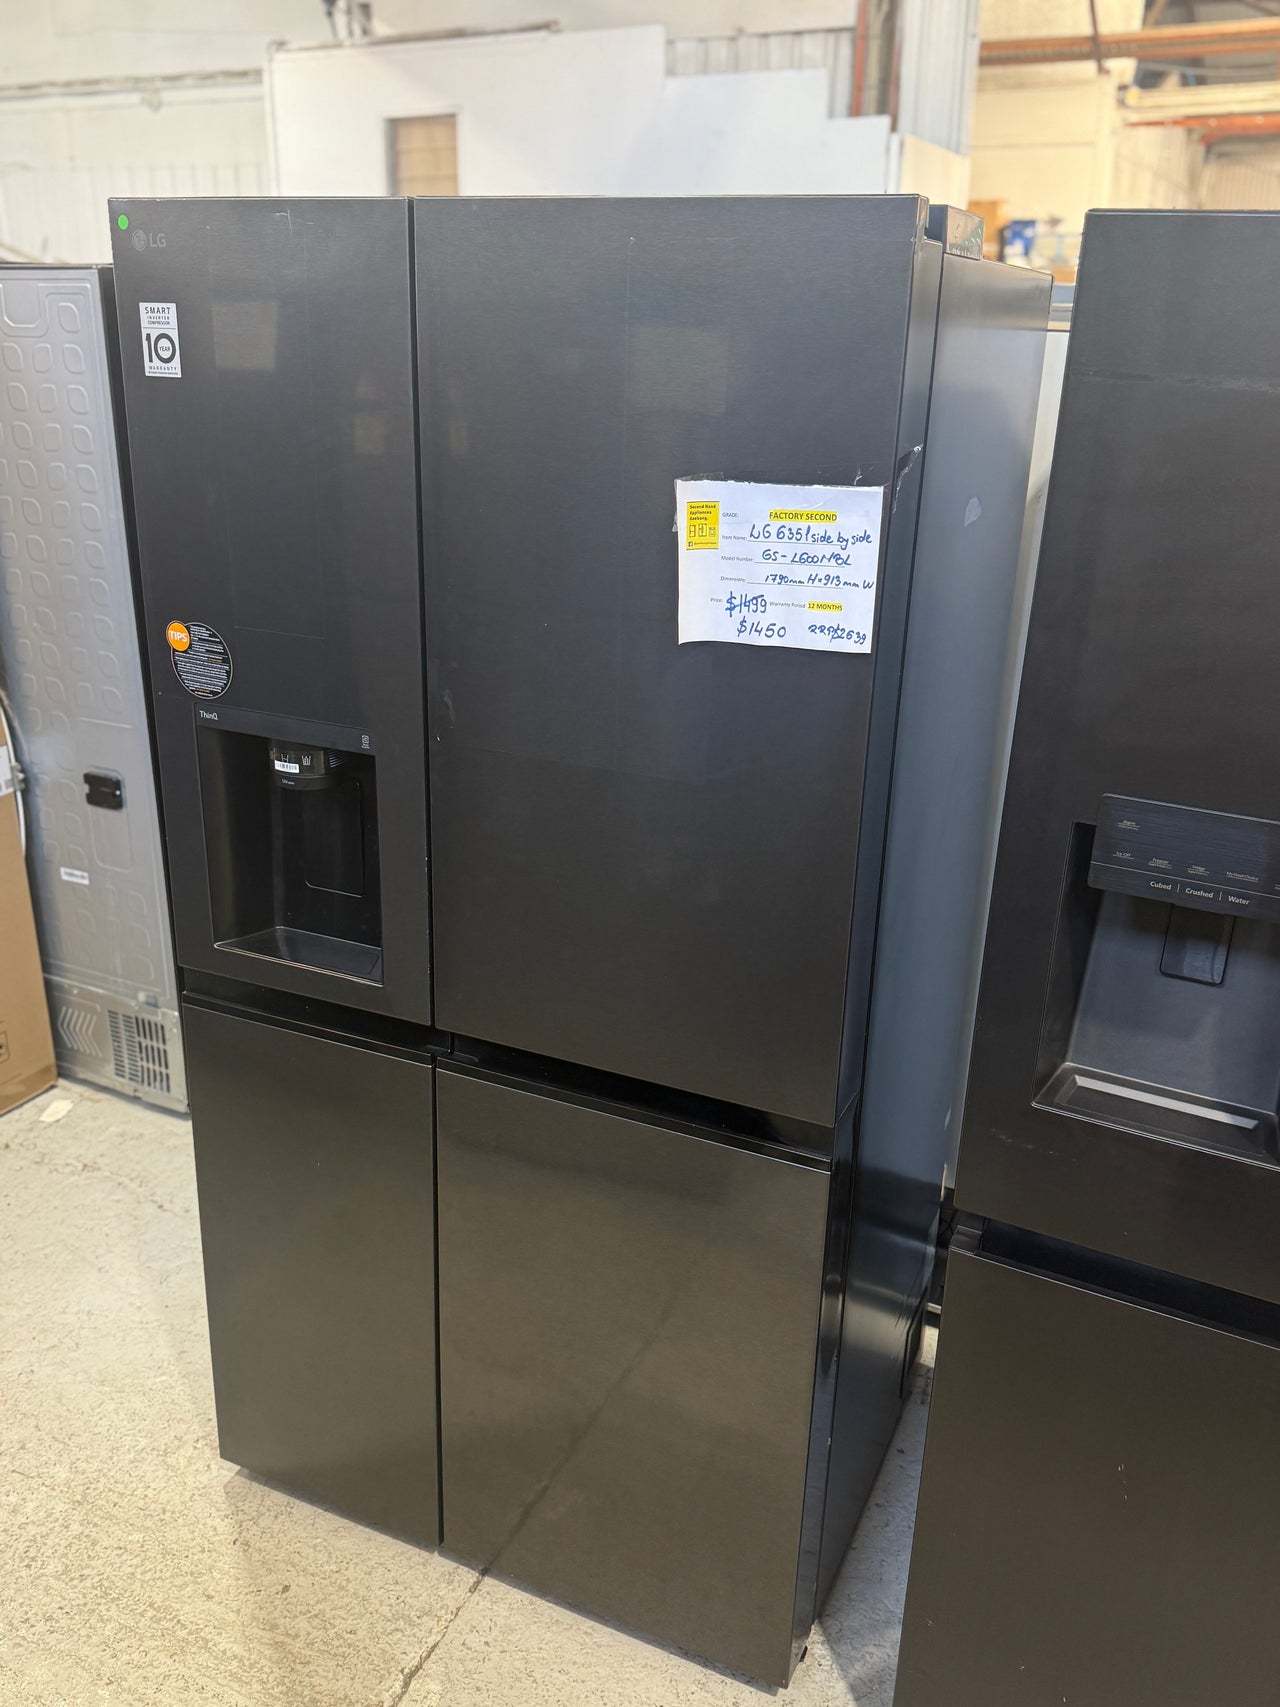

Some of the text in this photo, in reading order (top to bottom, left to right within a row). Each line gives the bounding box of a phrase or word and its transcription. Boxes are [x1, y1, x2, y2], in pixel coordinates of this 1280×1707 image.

[149, 233, 167, 248] LG
[145, 306, 171, 315] SMART
[145, 332, 177, 364] 10
[769, 511, 838, 522] FACTORY SECOND
[811, 529, 834, 544] side
[836, 531, 849, 551] by
[851, 529, 873, 545] side
[816, 603, 843, 611] MONTHS
[737, 615, 787, 638] $1450
[169, 630, 188, 643] TIPS
[200, 710, 219, 721] ThinQ
[1150, 881, 1172, 890] Cubed
[1185, 888, 1214, 898] Crushed
[1228, 895, 1251, 905] Water
